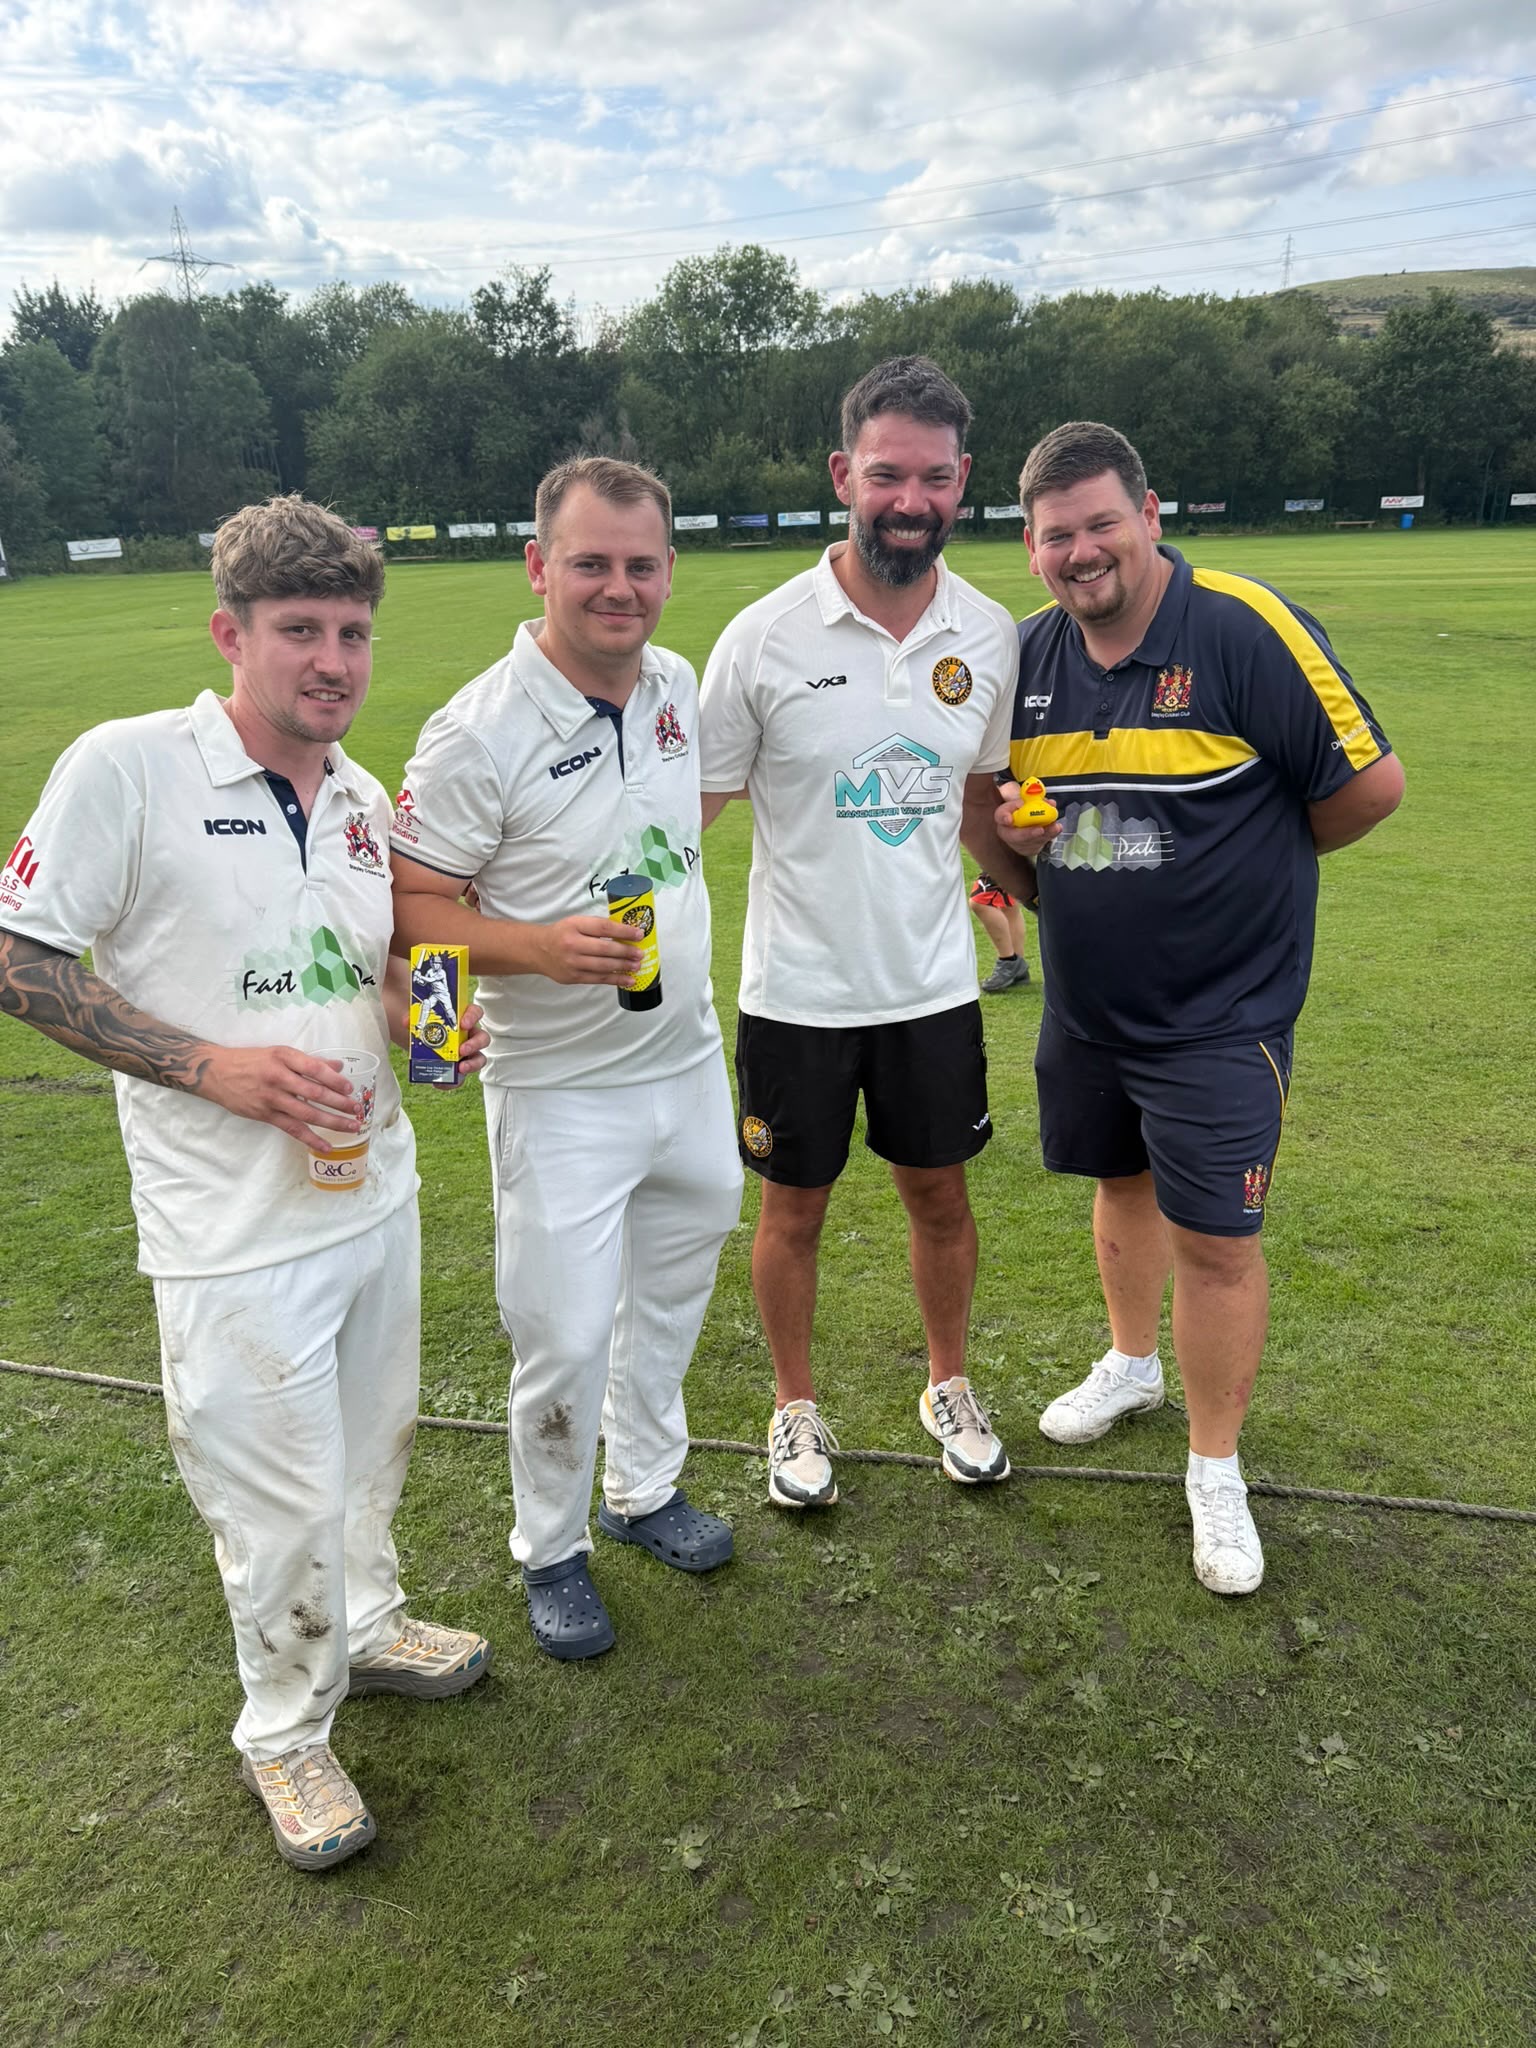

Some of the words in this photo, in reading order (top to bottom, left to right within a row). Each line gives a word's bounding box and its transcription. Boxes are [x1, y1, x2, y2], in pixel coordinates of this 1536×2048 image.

[549, 746, 602, 780] ICON
[835, 766, 953, 807] MVS
[203, 819, 267, 835] ICON
[836, 808, 900, 818] MANCHESTER
[900, 805, 922, 815] VAN
[243, 969, 297, 1000] Fast
